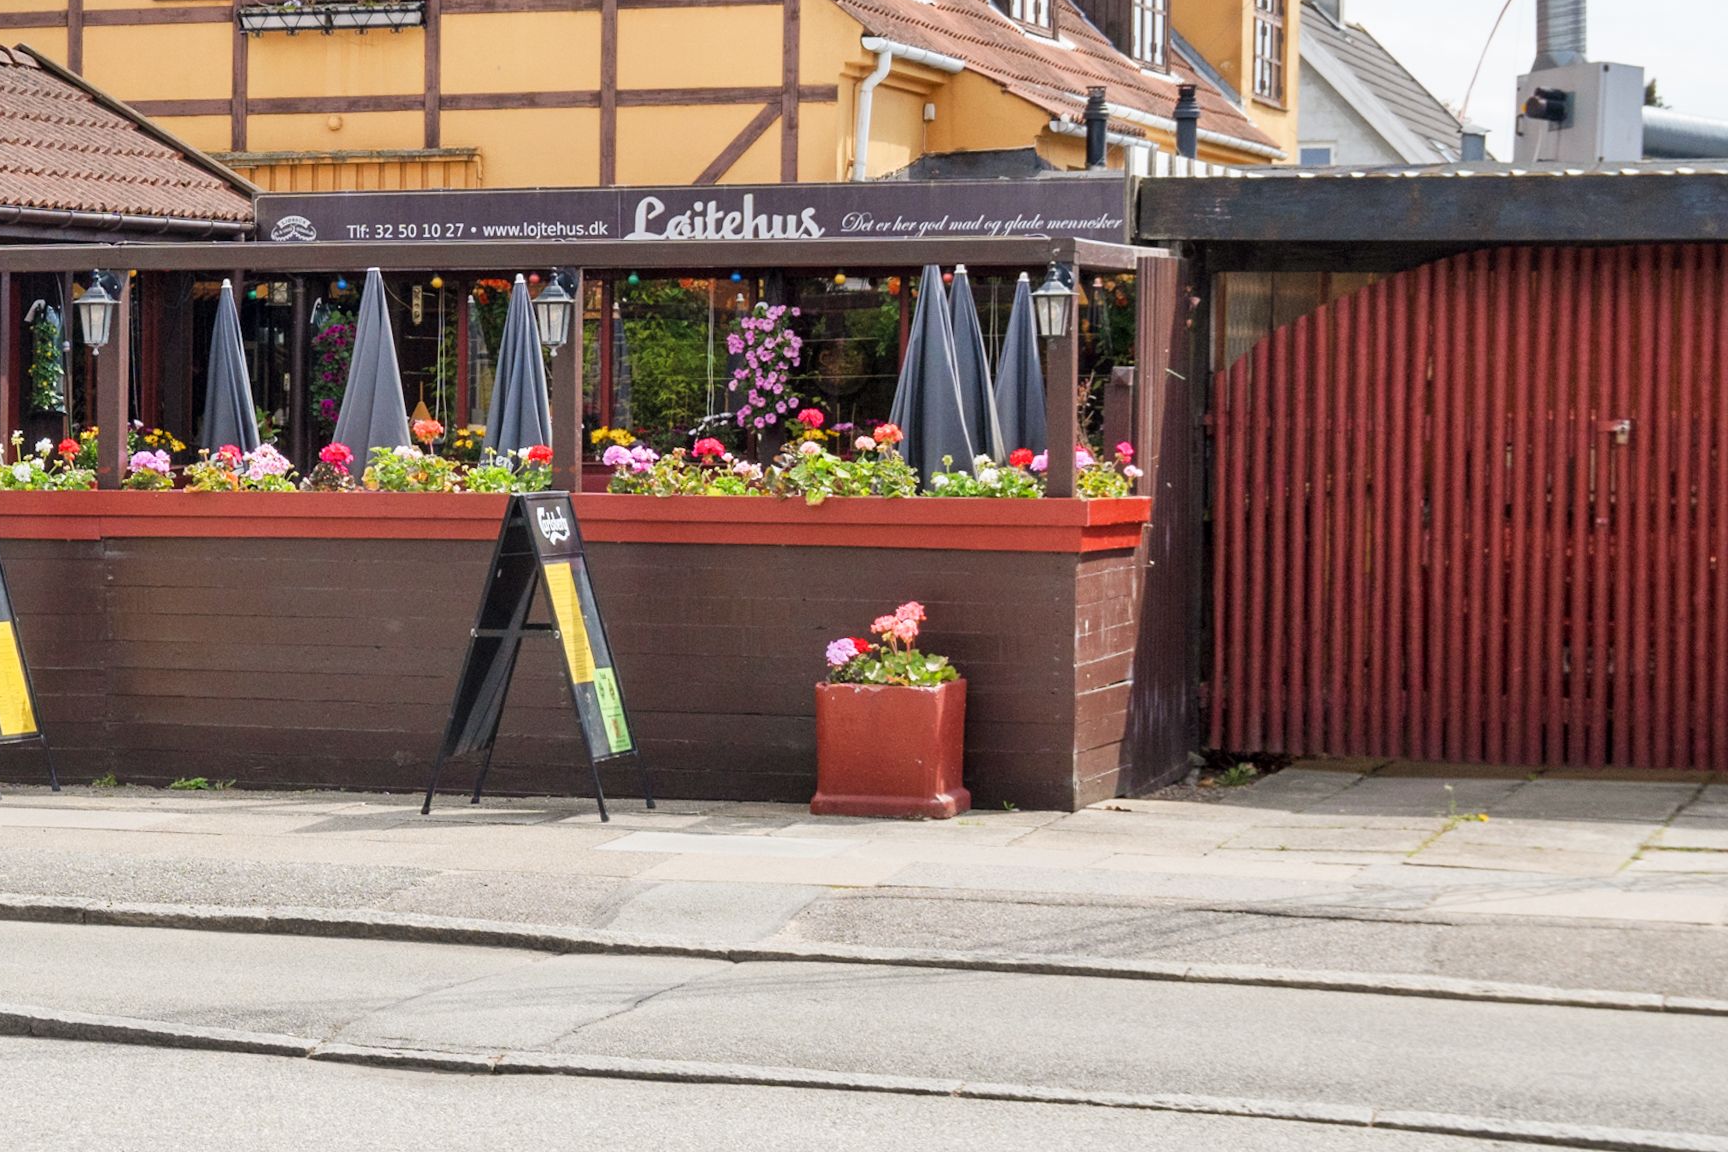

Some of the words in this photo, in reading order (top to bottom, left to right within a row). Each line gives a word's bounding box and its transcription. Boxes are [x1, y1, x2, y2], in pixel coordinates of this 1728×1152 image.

[346, 224, 370, 238] Tlf:
[374, 224, 393, 238] 32
[398, 223, 417, 238] 50
[422, 223, 441, 237] 10
[445, 223, 465, 237] 27
[482, 221, 609, 239] www.lojtehus.dk
[840, 212, 874, 232] Det
[875, 220, 891, 231] er
[892, 216, 916, 231] her
[914, 215, 949, 237] god
[948, 215, 985, 230] mad
[983, 220, 1002, 236] og
[1001, 214, 1044, 236] glade
[1046, 213, 1122, 229] mennesker
[536, 506, 570, 545] Carlsberg
